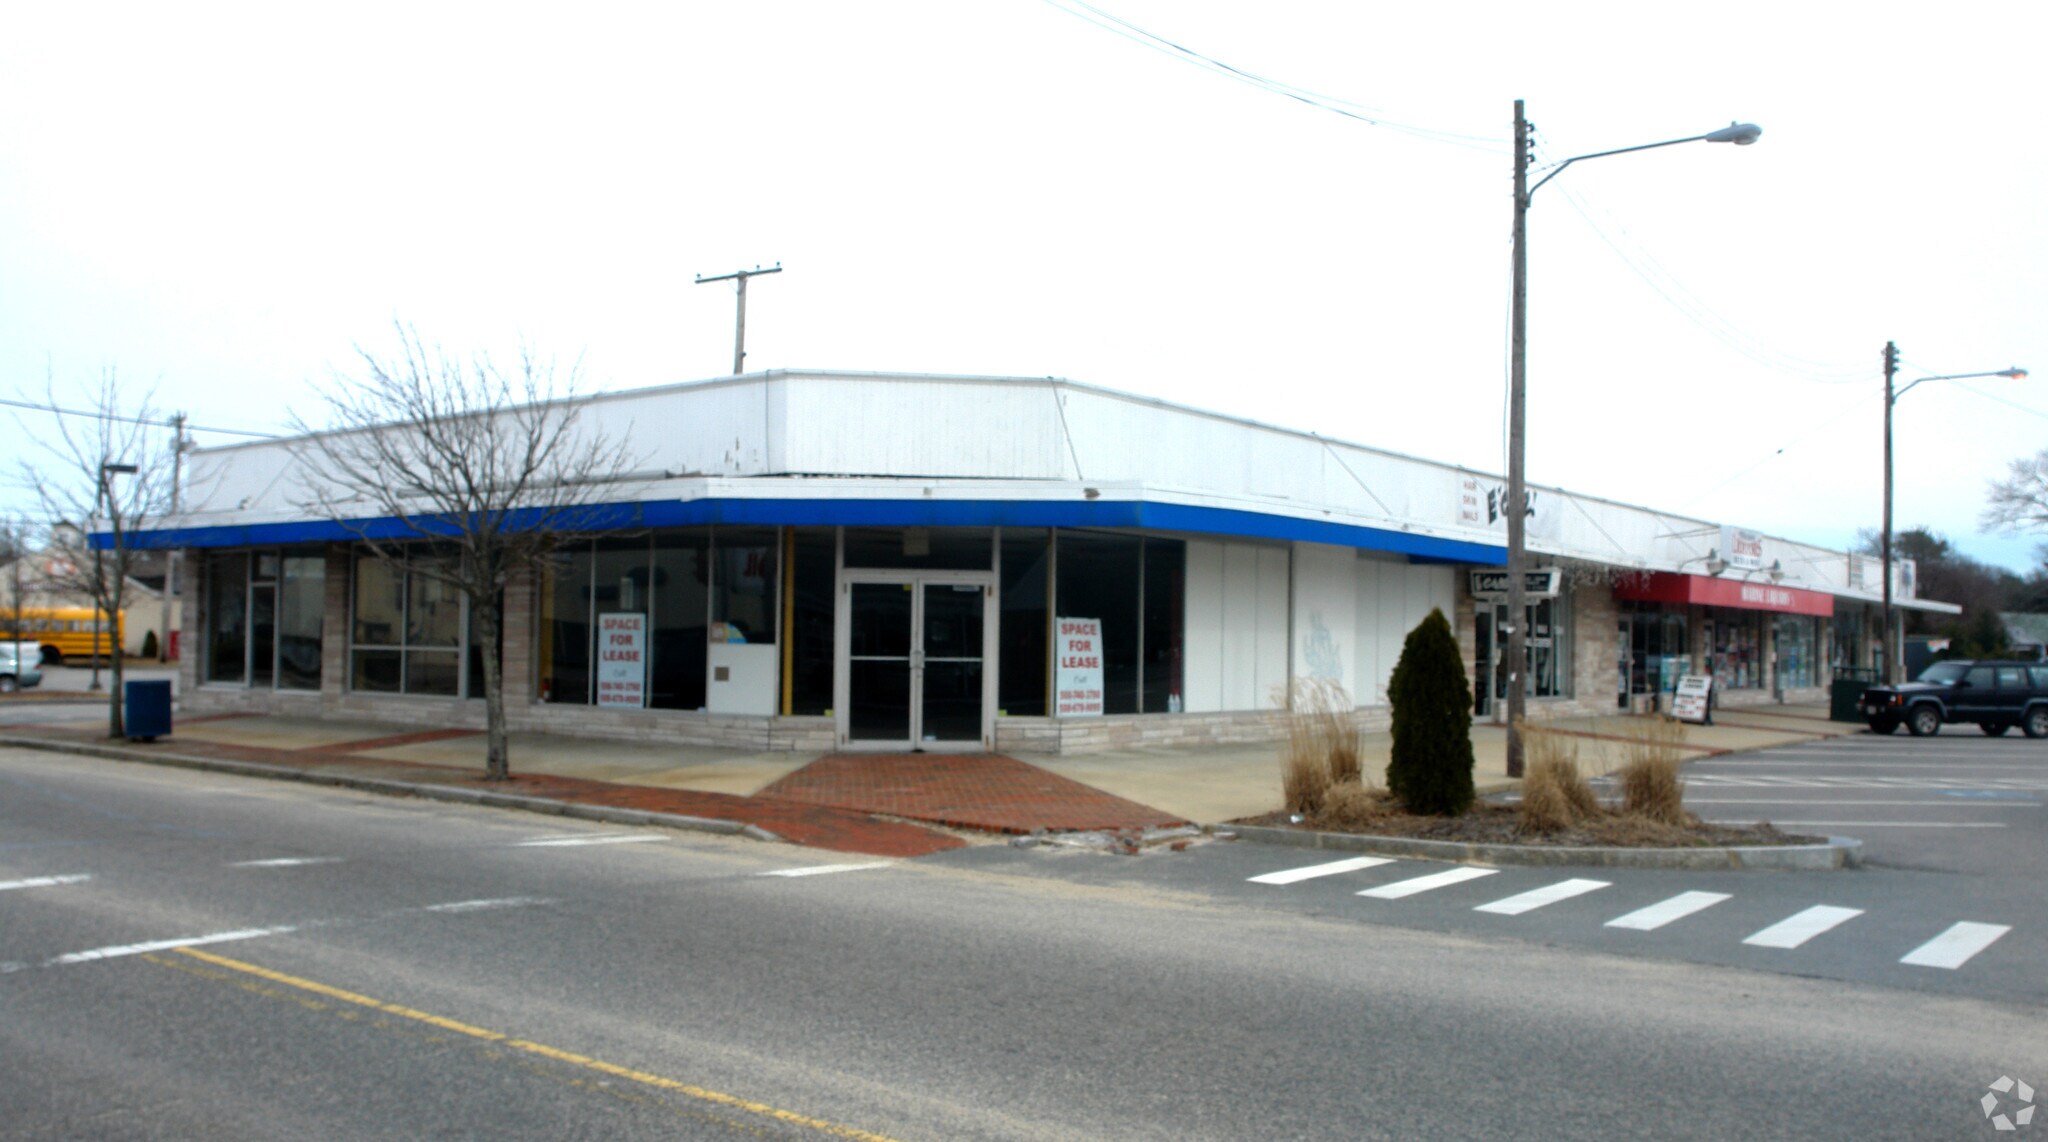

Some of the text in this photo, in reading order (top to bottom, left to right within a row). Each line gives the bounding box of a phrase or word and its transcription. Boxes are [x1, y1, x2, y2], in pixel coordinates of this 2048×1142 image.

[604, 619, 640, 631] SPACE
[1061, 623, 1097, 636] SPACE
[610, 634, 633, 646] FOR
[1068, 640, 1092, 652] FOR
[603, 651, 640, 663] LEASE
[1062, 657, 1099, 669] LEASE
